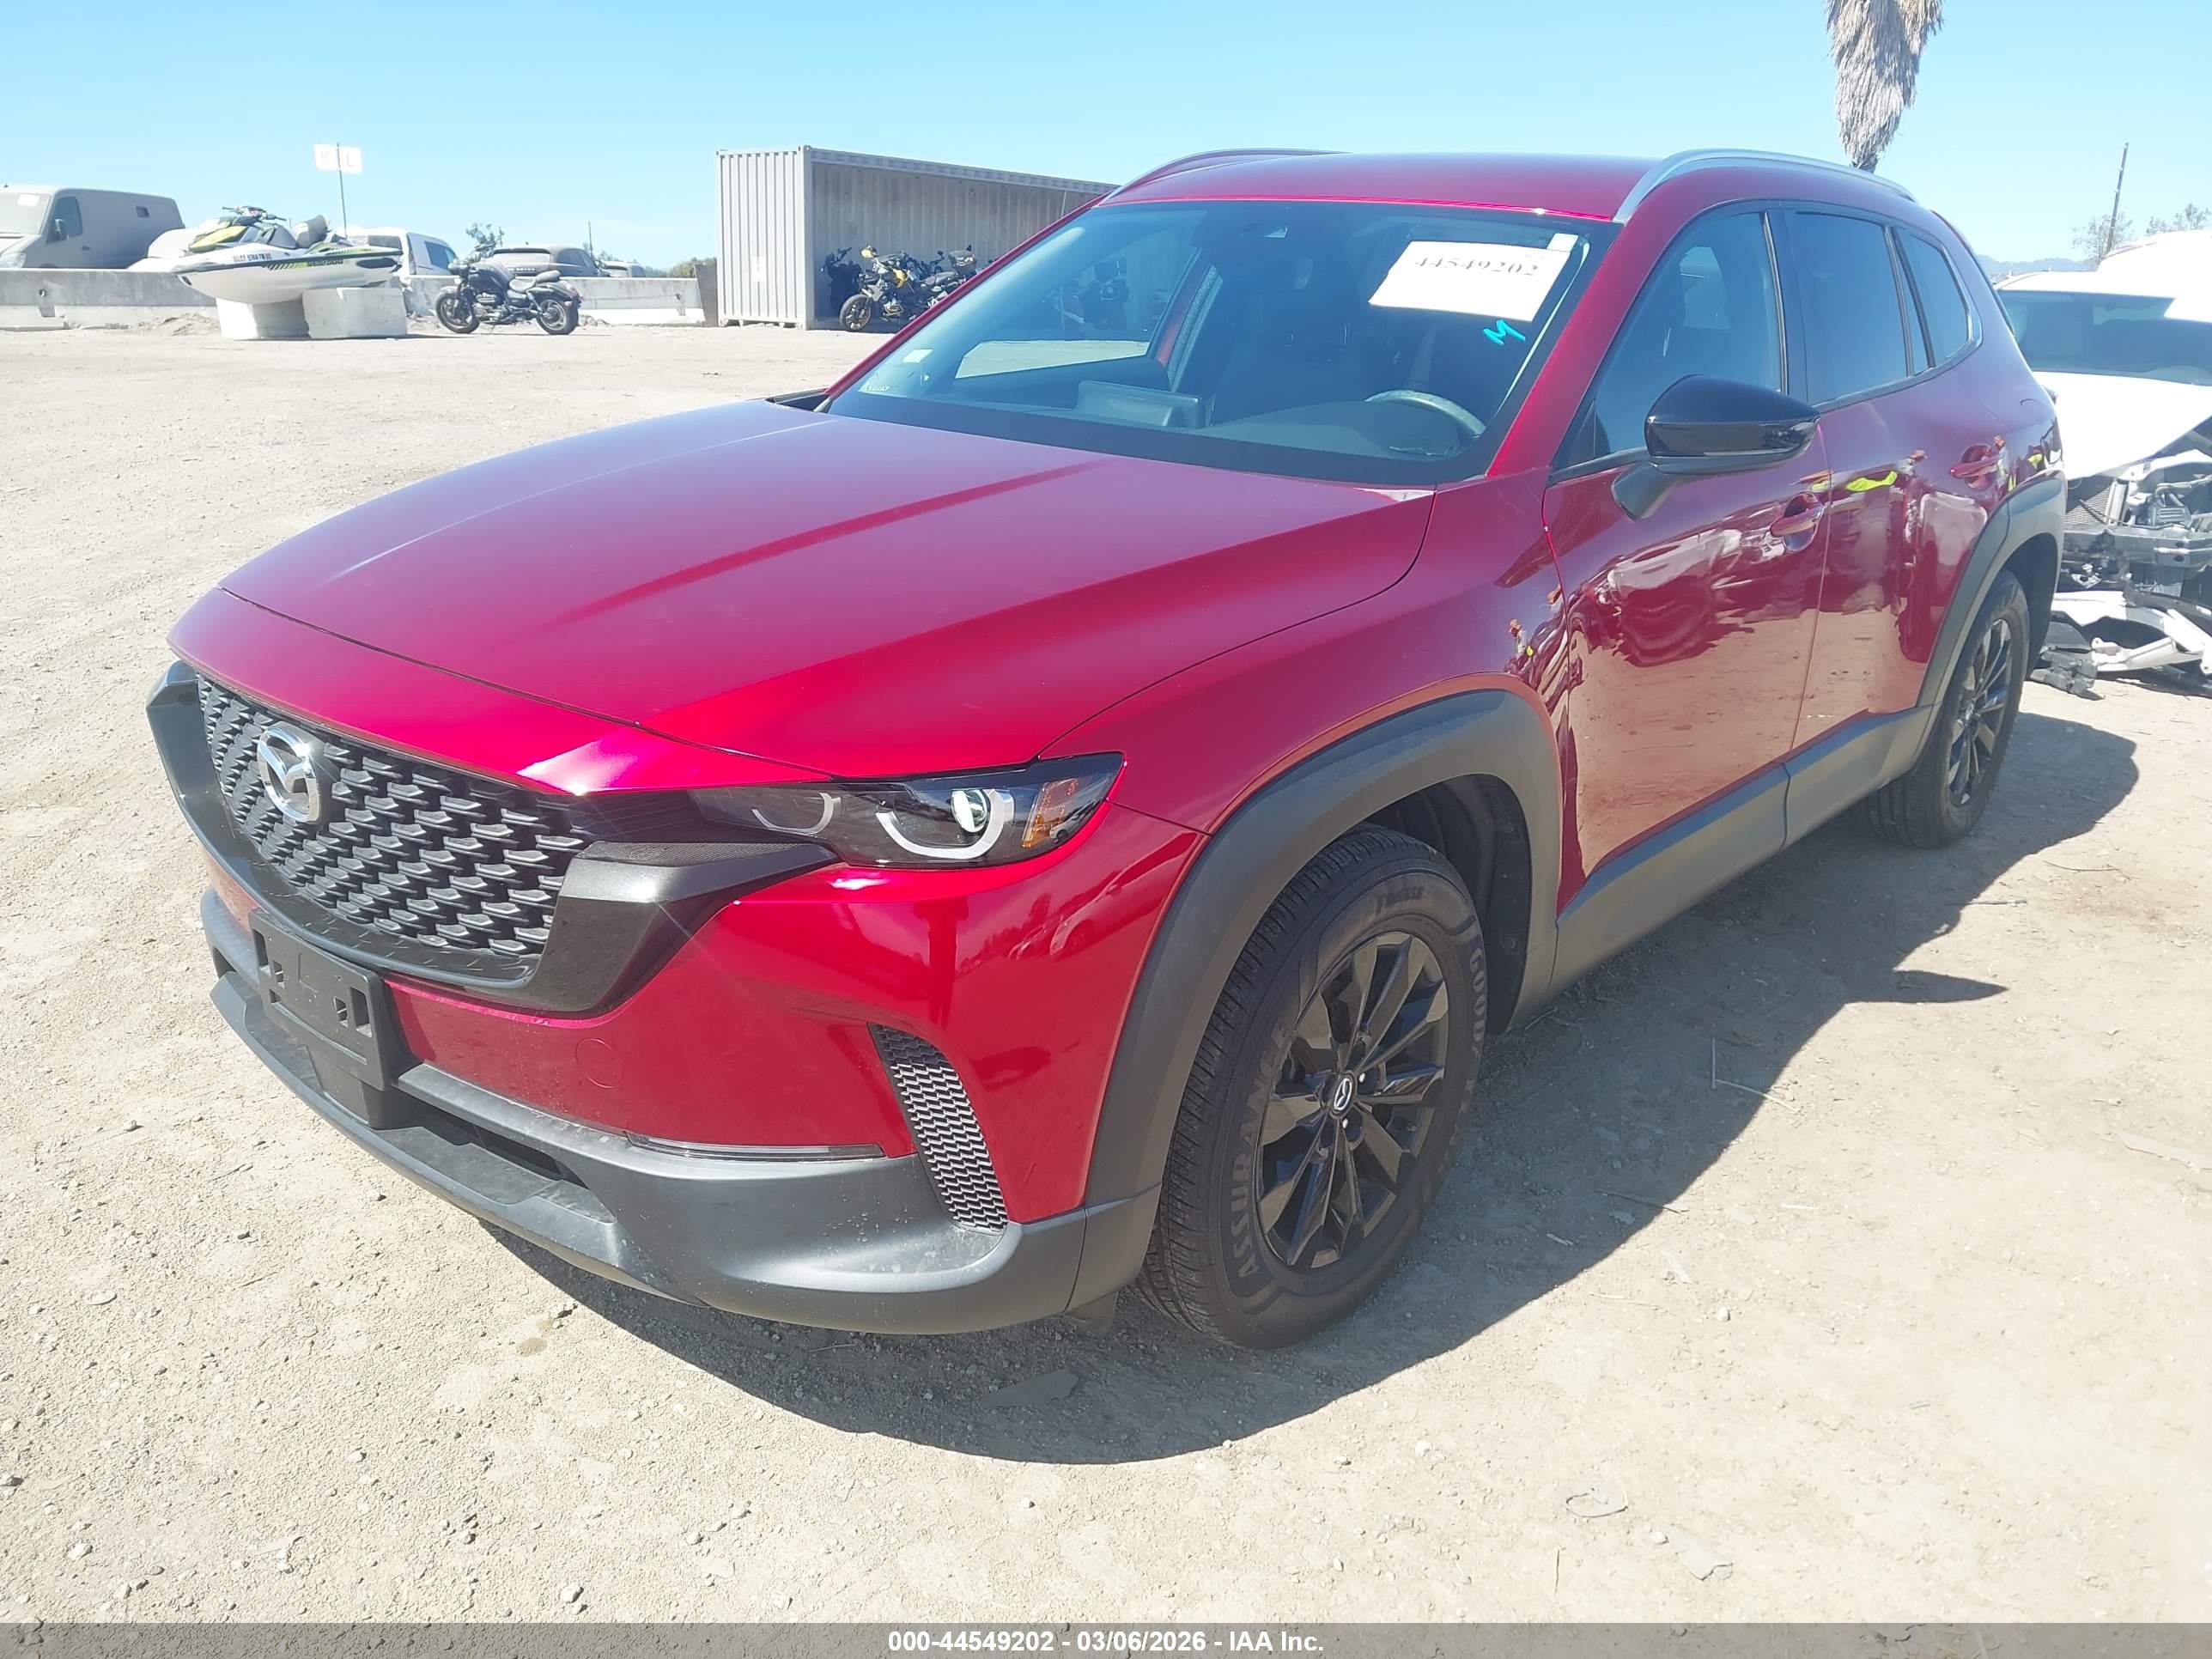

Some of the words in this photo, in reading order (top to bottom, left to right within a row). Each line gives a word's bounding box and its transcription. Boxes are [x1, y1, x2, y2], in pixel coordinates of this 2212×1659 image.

[1414, 257, 1538, 276] 44549202
[1483, 319, 1526, 345] M
[1229, 1016, 1290, 1279] ASSURANCE
